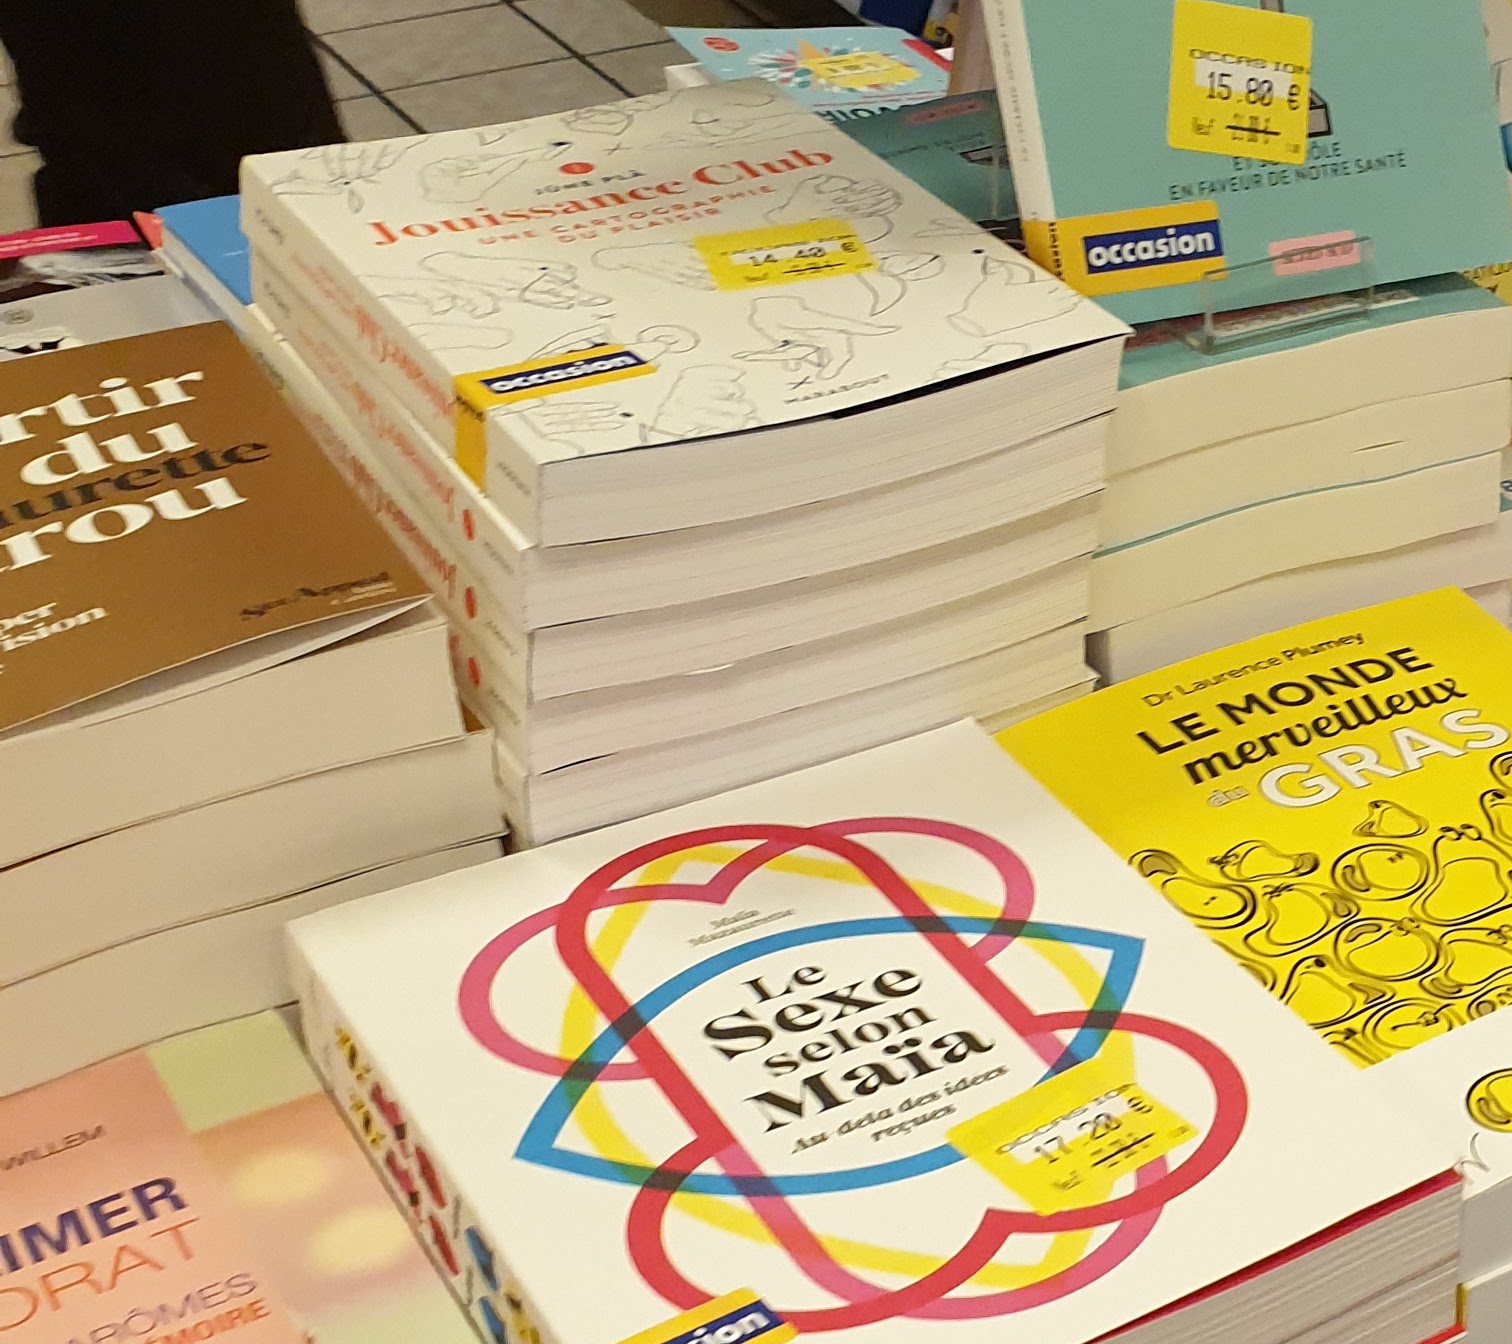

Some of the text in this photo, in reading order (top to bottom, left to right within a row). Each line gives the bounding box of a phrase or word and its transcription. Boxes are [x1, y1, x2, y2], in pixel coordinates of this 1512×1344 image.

[367, 148, 833, 246] Jouissance Club
[1168, 150, 1408, 204] EN FAVEUR DE NOTRE SANTÉ
[1087, 229, 1215, 268] occasion
[490, 354, 640, 393] occasion
[20, 422, 199, 485] du
[1136, 646, 1434, 756] LE MONDE
[1142, 630, 1364, 708] Dr Laurence Plumey
[1184, 674, 1470, 786] merveilleux
[1206, 708, 1512, 808] du GRAS
[702, 964, 925, 1063] Sexe
[739, 964, 828, 1005] Le
[764, 1001, 938, 1079] selon
[742, 1026, 997, 1134] Maïa
